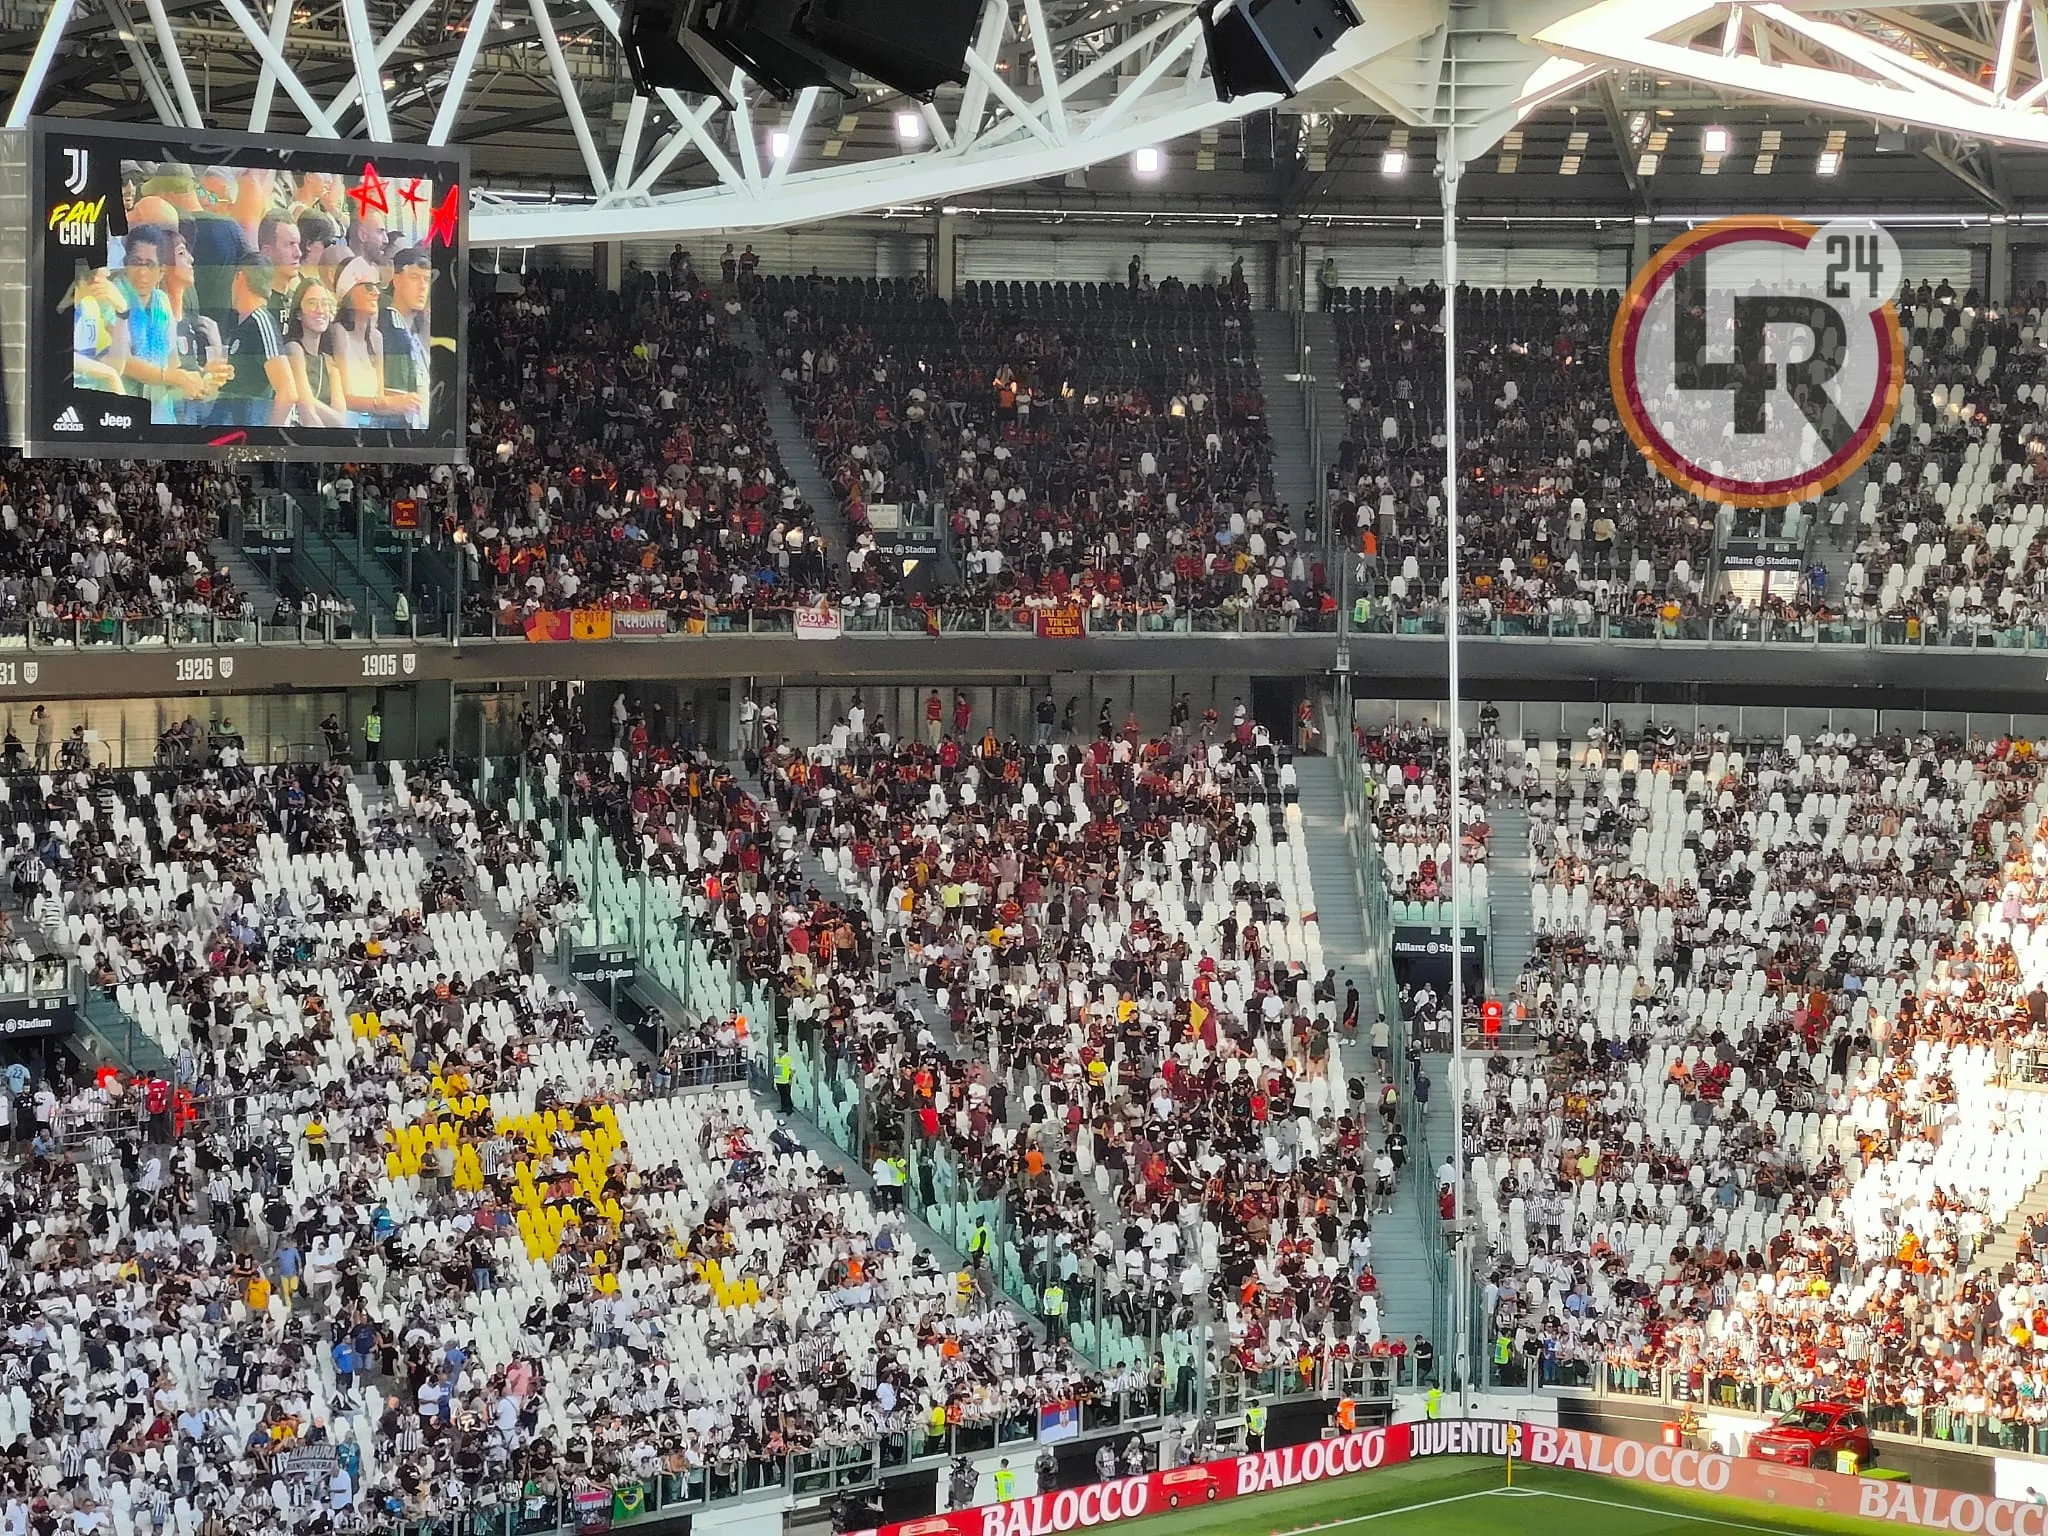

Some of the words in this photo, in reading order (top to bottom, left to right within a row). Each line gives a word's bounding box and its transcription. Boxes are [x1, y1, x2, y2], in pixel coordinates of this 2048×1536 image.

[49, 194, 106, 231] FAN
[60, 220, 95, 246] CAM
[52, 422, 84, 432] adidas
[99, 412, 132, 429] Jeep
[904, 545, 937, 554] Stadium
[1723, 556, 1754, 565] Allianz
[1765, 556, 1801, 566] Stadium
[617, 614, 667, 629] PIEMONTE
[176, 657, 213, 681] 1926
[361, 654, 397, 676] 1905
[1395, 942, 1426, 953] Allianz
[1439, 943, 1476, 953] Staum
[17, 1018, 52, 1030] Stadium
[1410, 1421, 1523, 1458] JUVENTUS
[1237, 1428, 1386, 1496] BALOCCO
[1526, 1425, 1732, 1491] BALOCCO
[981, 1475, 1149, 1536] BALOCCO
[1858, 1477, 2048, 1536] BALOCC
